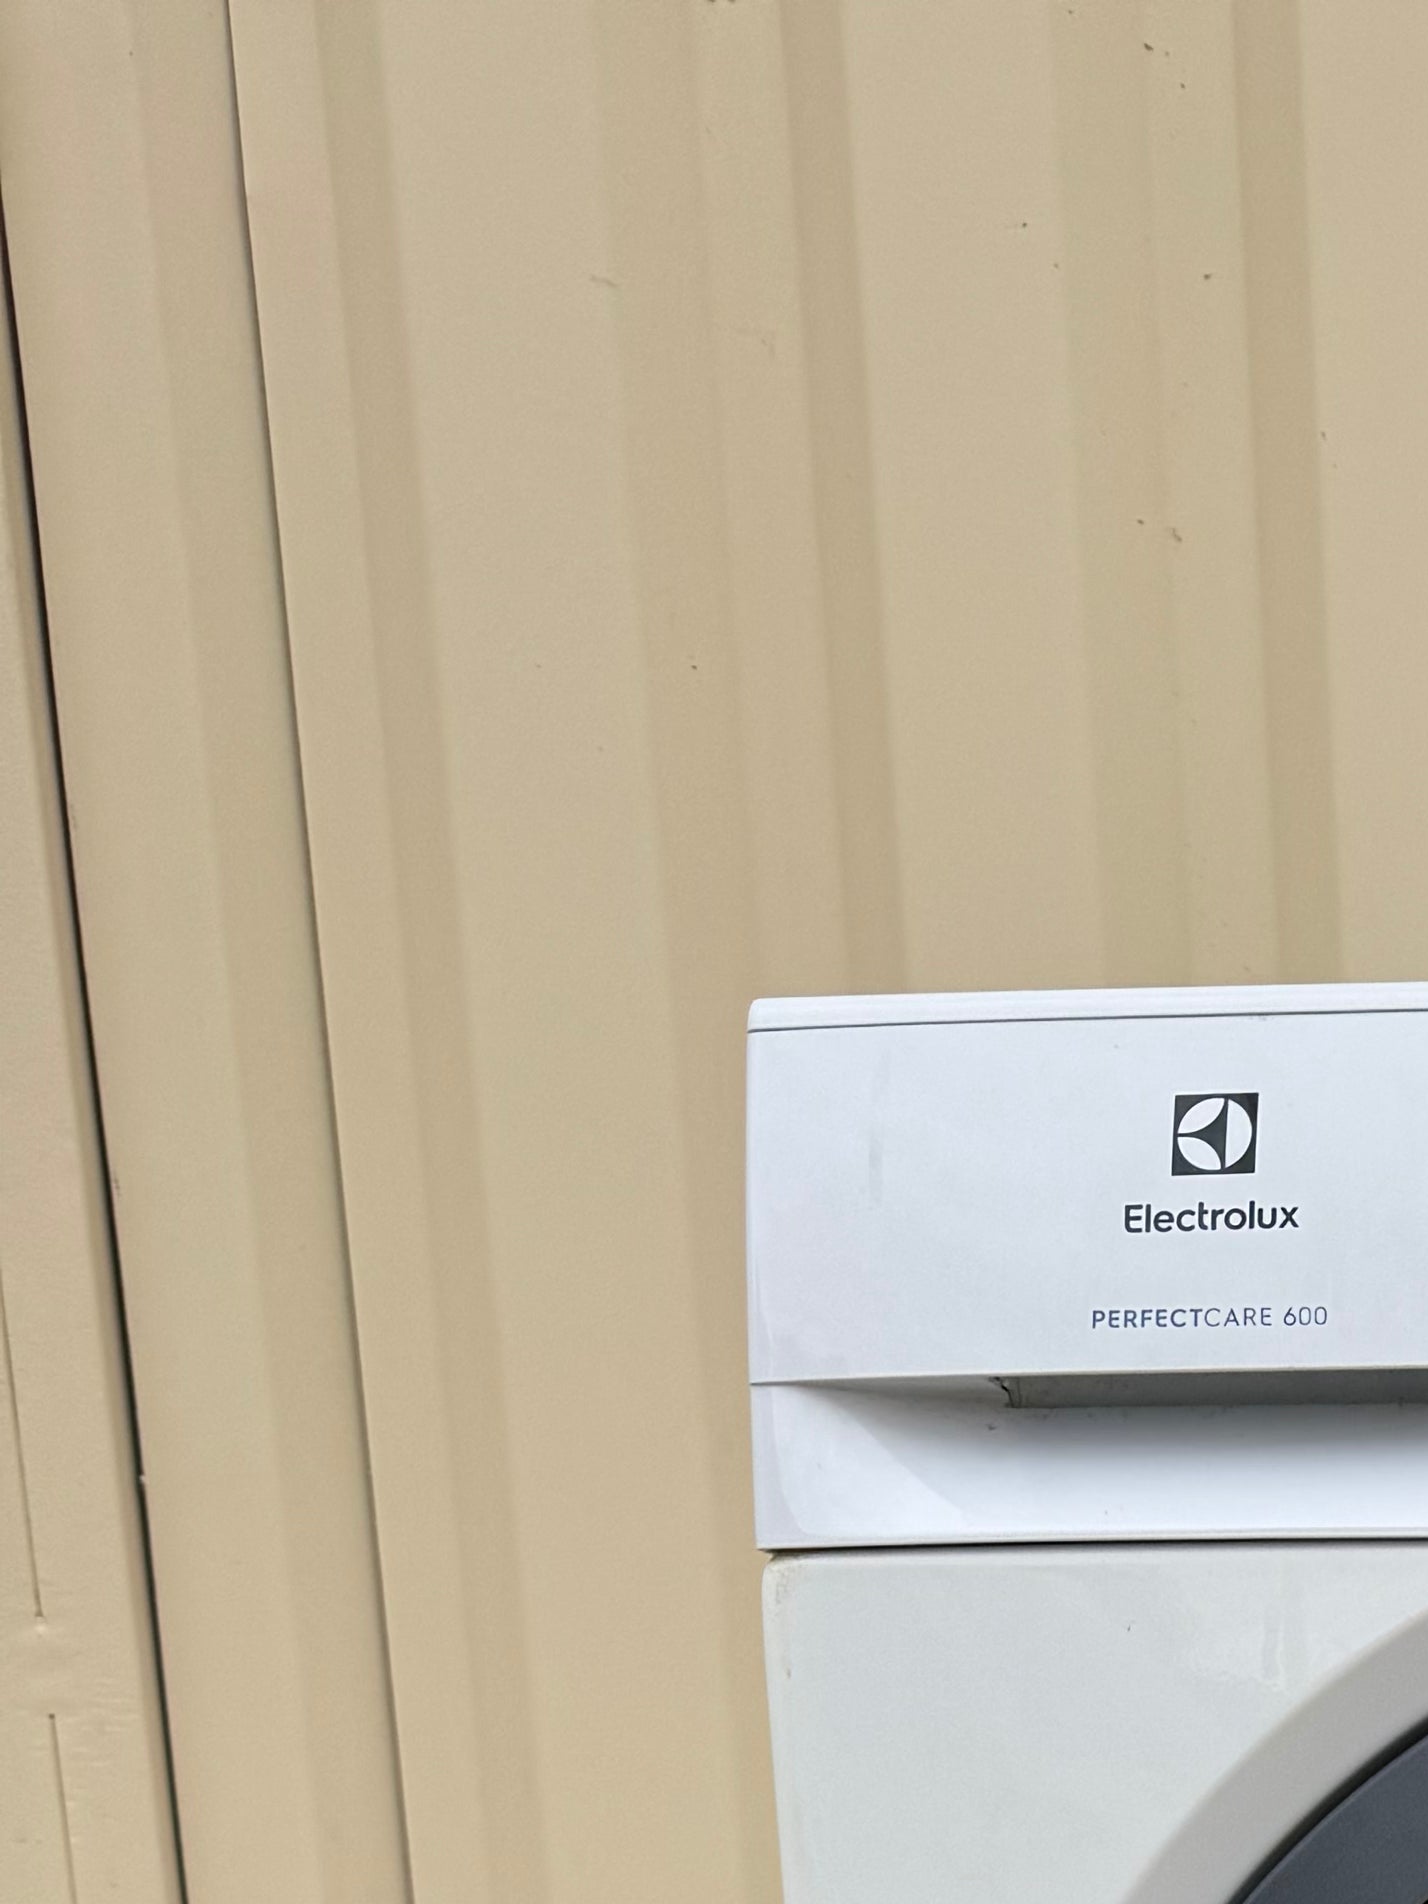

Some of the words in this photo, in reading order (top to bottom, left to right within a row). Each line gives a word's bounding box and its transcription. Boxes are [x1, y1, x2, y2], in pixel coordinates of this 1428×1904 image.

[1124, 1200, 1300, 1234] Electrolux
[1092, 1307, 1273, 1329] PERFECTCARE
[1283, 1306, 1328, 1327] 600
